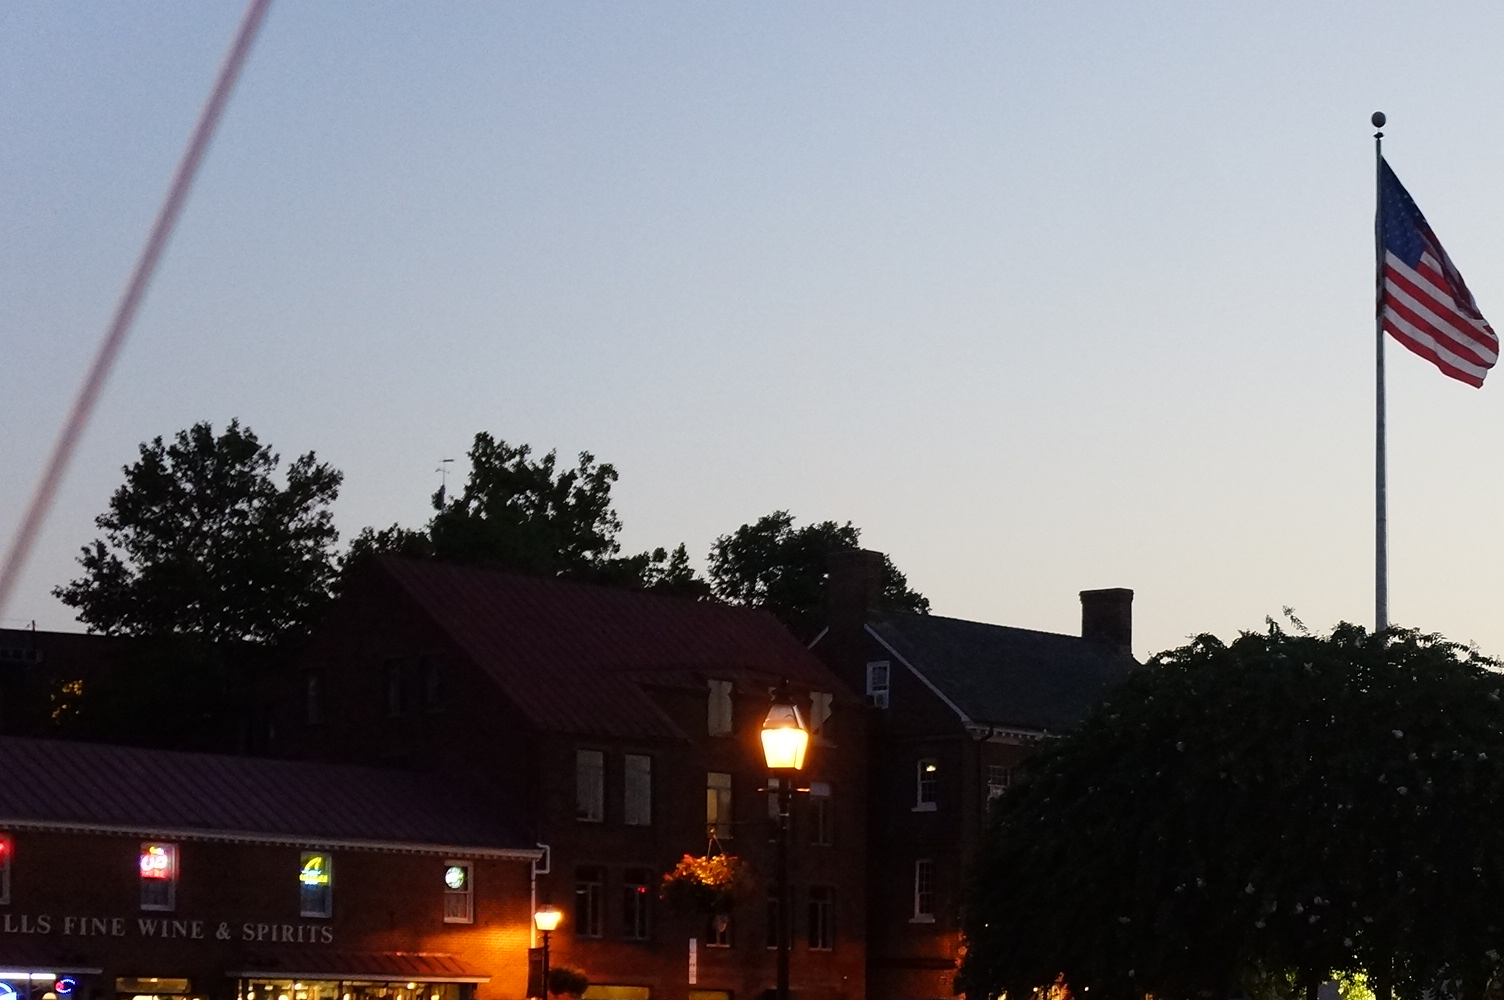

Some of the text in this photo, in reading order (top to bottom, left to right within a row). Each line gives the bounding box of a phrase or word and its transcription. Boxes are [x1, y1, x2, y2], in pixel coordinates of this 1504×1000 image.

[4, 914, 333, 944] LLS FINE WINE & SPIRITS
